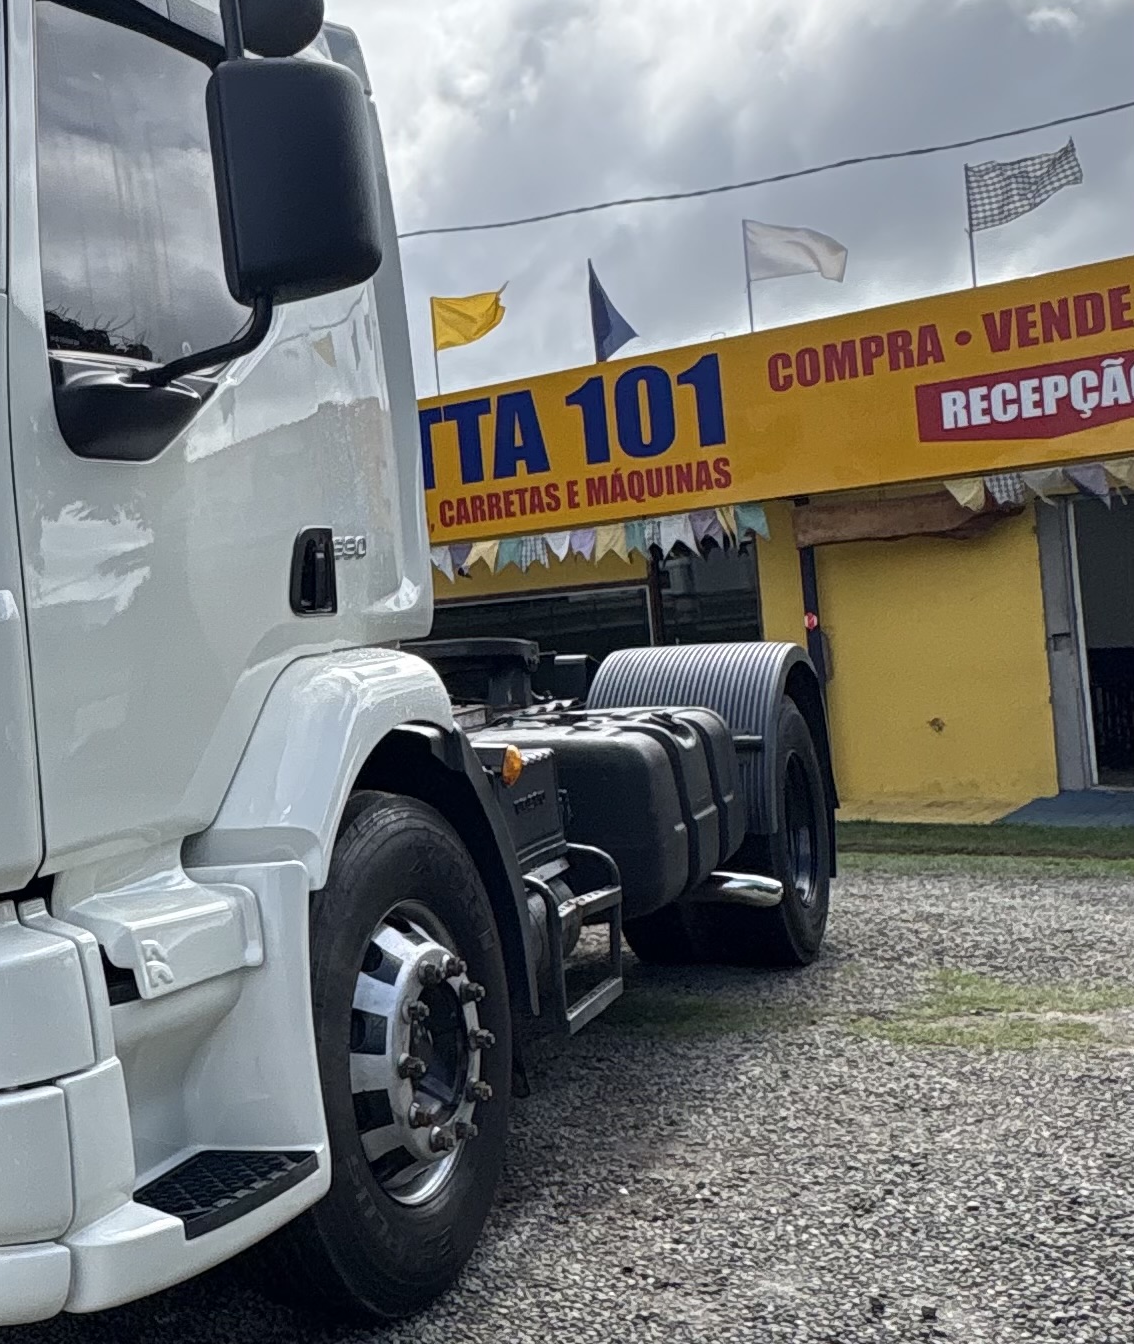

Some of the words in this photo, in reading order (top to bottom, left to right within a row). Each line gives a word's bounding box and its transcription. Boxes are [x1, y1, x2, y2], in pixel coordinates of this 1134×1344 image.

[768, 323, 945, 392] COMPRA
[982, 285, 1134, 353] VENDE
[565, 353, 727, 466] 101
[940, 356, 1134, 429] RECEPÇÃ
[439, 482, 562, 529] CARRETAS
[567, 480, 580, 509] E
[586, 457, 732, 507] MÁQUINAS
